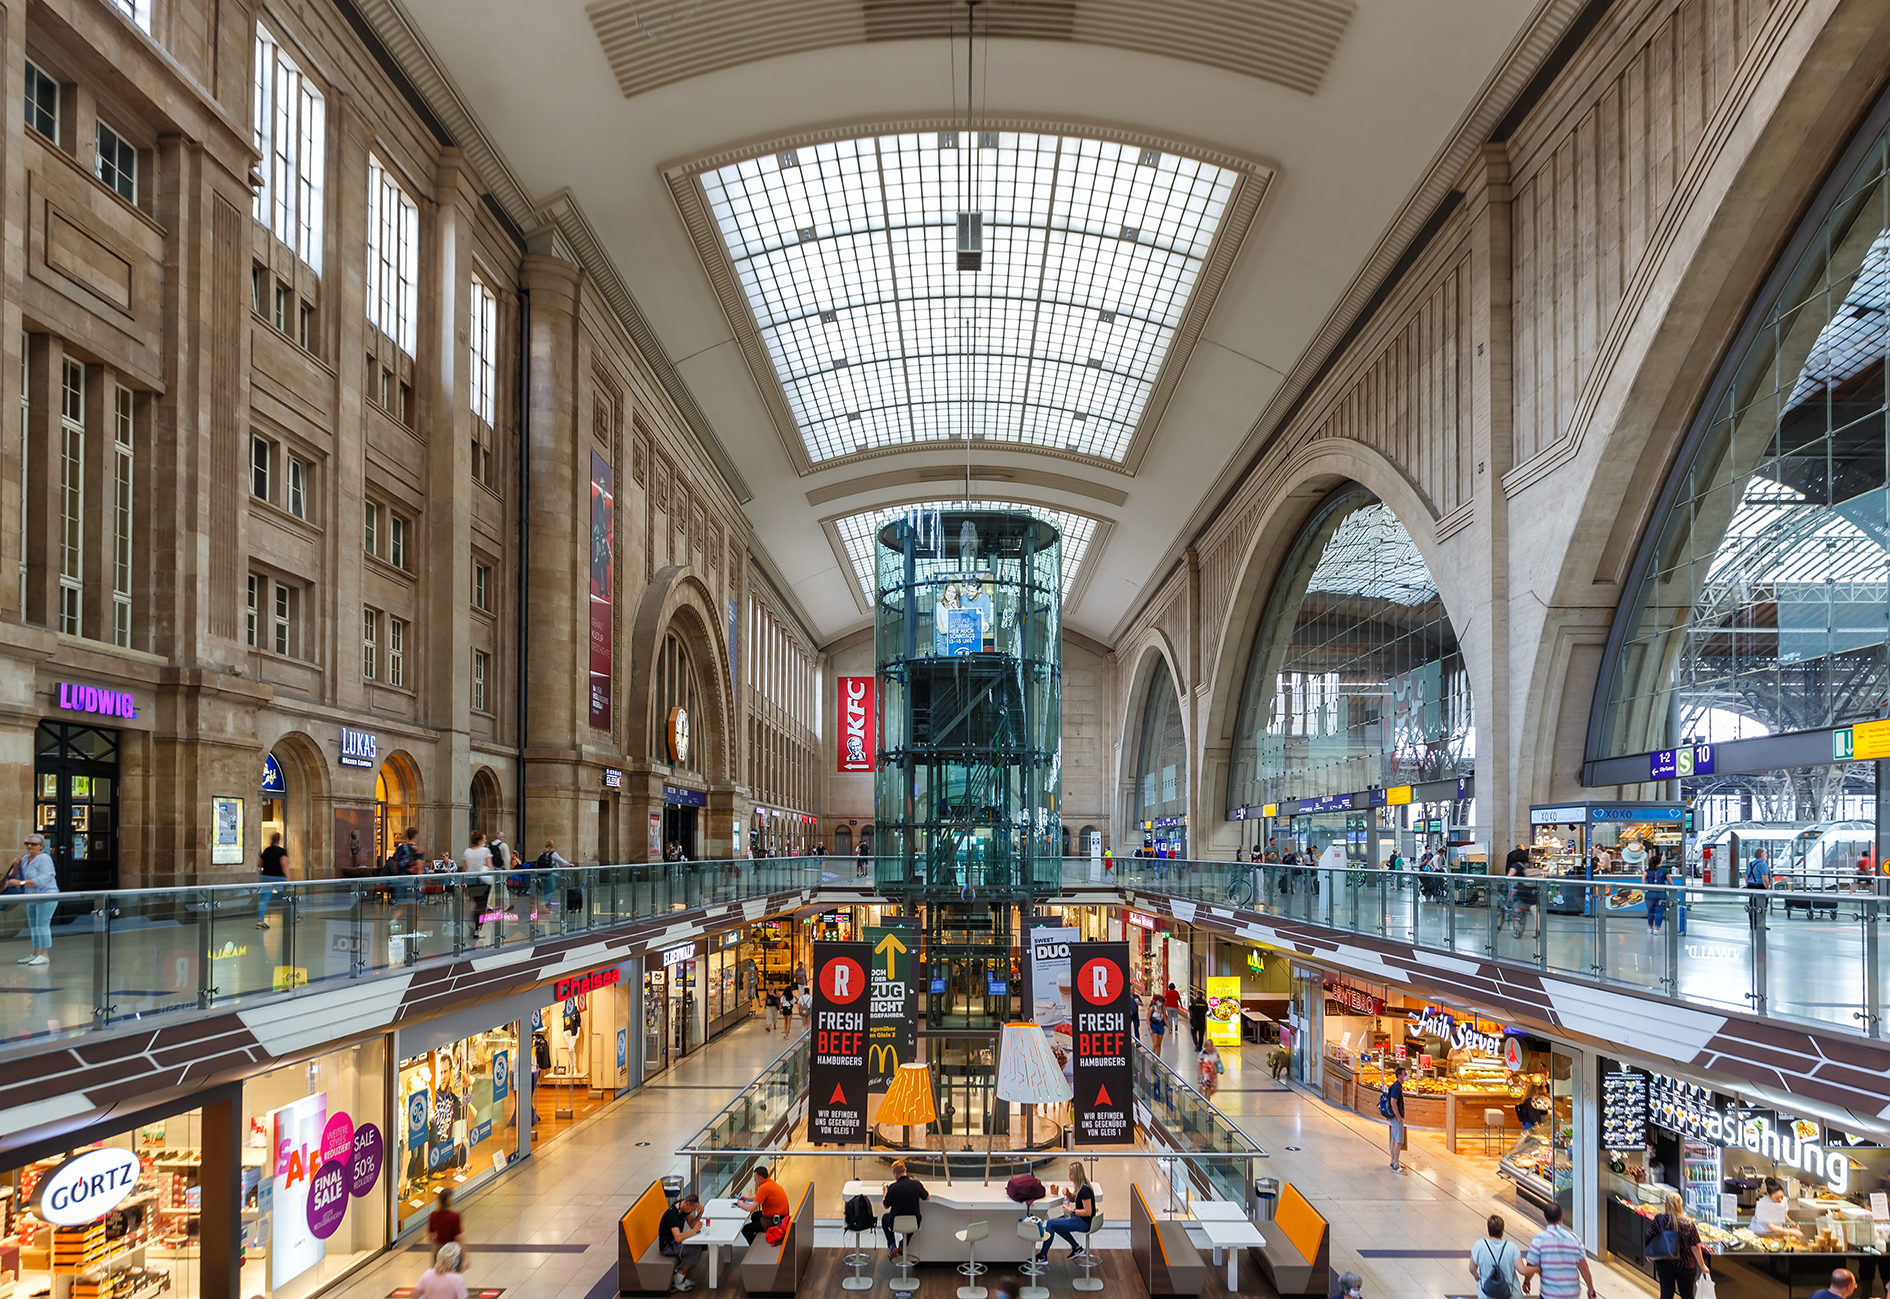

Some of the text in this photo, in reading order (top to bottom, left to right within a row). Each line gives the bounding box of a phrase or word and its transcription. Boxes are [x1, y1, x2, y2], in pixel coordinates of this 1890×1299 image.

[847, 680, 865, 739] KFC
[1660, 752, 1670, 763] 1-2
[1680, 752, 1691, 773] S
[1697, 746, 1710, 763] 10
[1460, 778, 1464, 790] 9
[1541, 811, 1558, 822] XOXO
[1606, 810, 1632, 819] XOXO
[557, 968, 620, 1002] Chelsea
[834, 965, 850, 996] R
[1093, 966, 1108, 997] R
[870, 984, 903, 998] ZUG
[1332, 984, 1379, 1016] ERNTEBROT
[818, 1011, 864, 1031] FRESH
[1078, 1013, 1124, 1032] FRESH
[818, 1032, 864, 1055] BEEF
[1080, 1033, 1125, 1056] BEEF
[1450, 1022, 1501, 1058] Servet
[817, 1055, 863, 1066] HAMBURGERS
[1080, 1057, 1126, 1067] HAMBURGERS
[815, 1118, 860, 1127] UNS GEGENÜBER
[818, 1110, 858, 1119] WIR BEFINDEN
[1082, 1119, 1126, 1128] UNS GEGENÜBER
[1084, 1112, 1124, 1120] WIR BEFINDEN
[327, 1124, 349, 1140] WEITERE
[820, 1126, 832, 1134] VON
[833, 1126, 850, 1134] GLEIS
[1088, 1128, 1099, 1136] VON
[1100, 1128, 1116, 1136] GLEIS
[329, 1134, 346, 1150] STYLES
[354, 1129, 374, 1152] SALE
[324, 1141, 352, 1161] REDUZIERT
[1708, 1111, 1848, 1194] asiahung
[354, 1154, 375, 1180] 50%
[315, 1168, 342, 1194] FINAL
[314, 1180, 342, 1211] SALE
